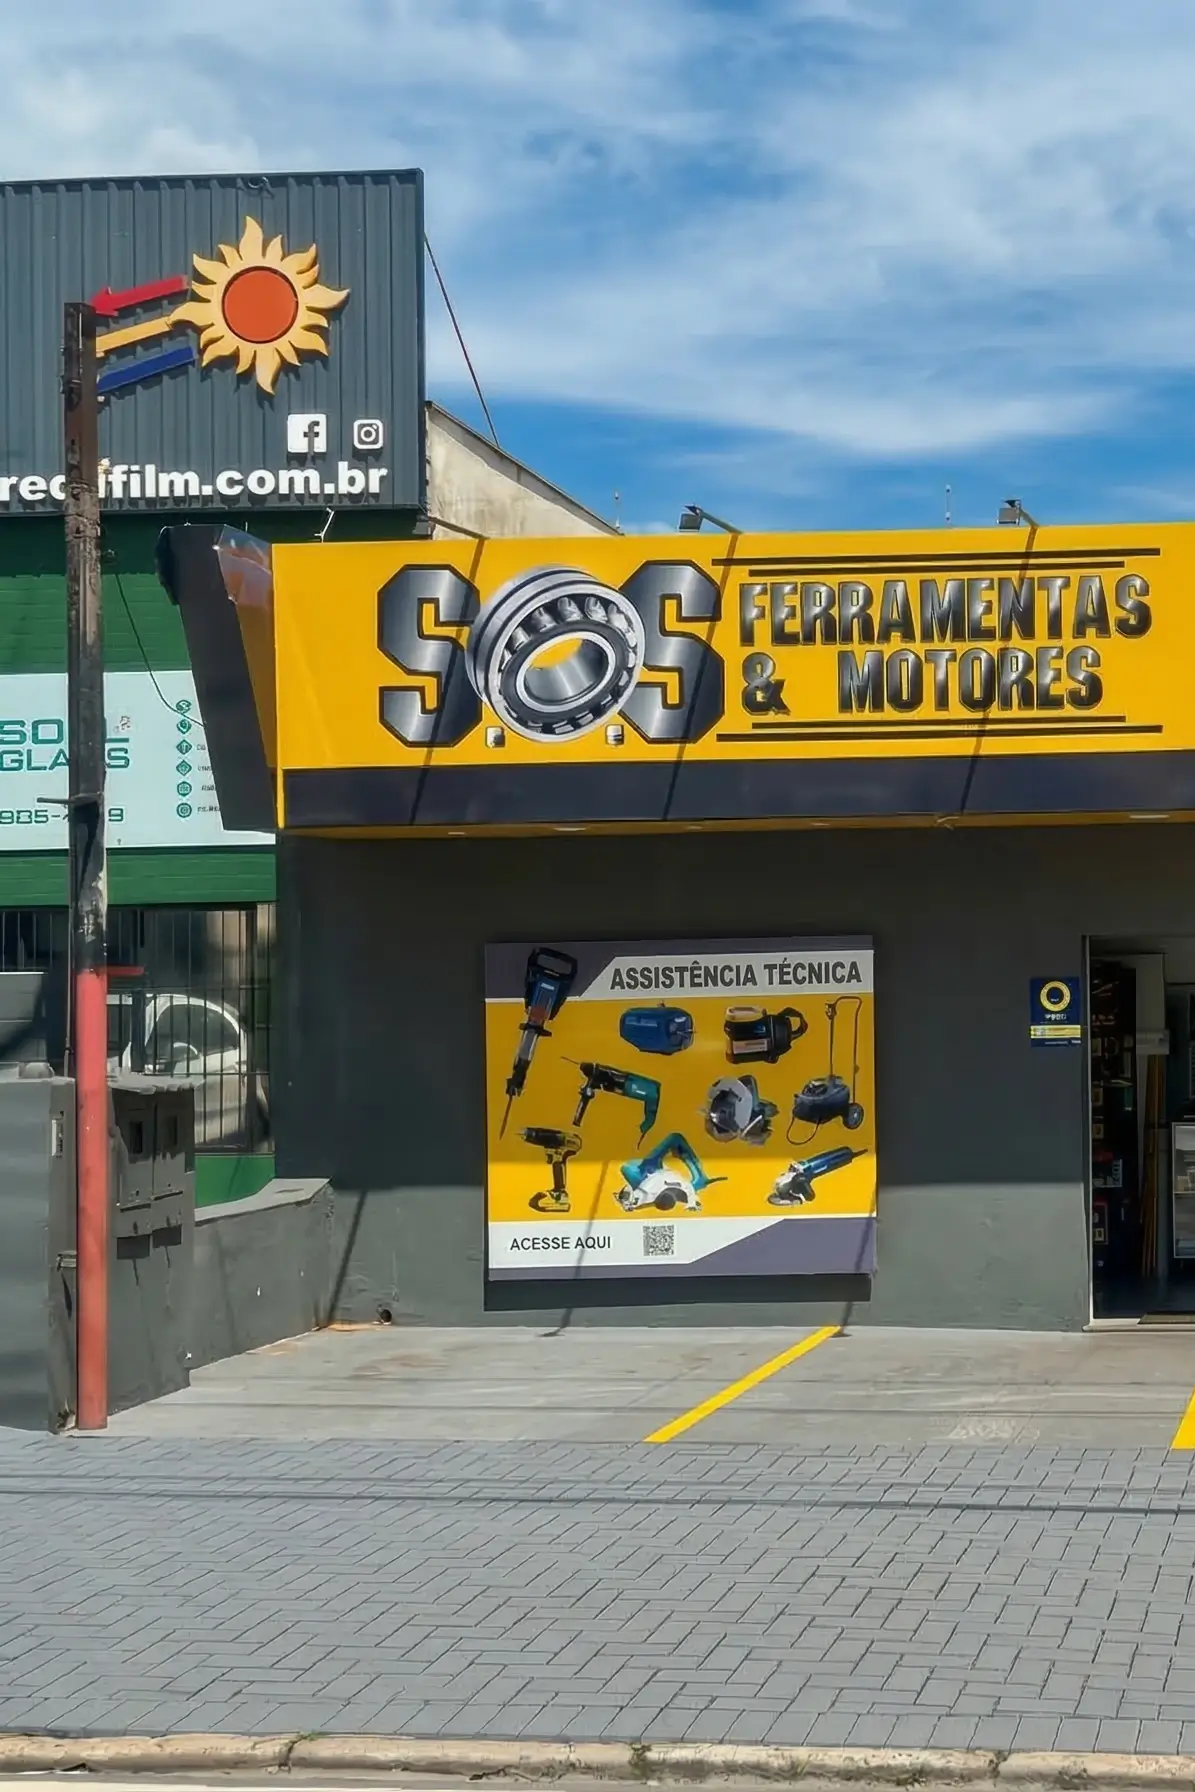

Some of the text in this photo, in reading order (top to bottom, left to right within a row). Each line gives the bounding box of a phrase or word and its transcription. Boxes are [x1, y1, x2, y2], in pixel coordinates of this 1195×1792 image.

[738, 573, 1152, 647] FERRAMENTAS
[741, 645, 1104, 716] & MOTORES
[0, 748, 130, 771] GLAS
[610, 957, 862, 990] ASSISTÊNCIA TÉCNICA
[509, 1235, 611, 1251] ACESSE AQUI
